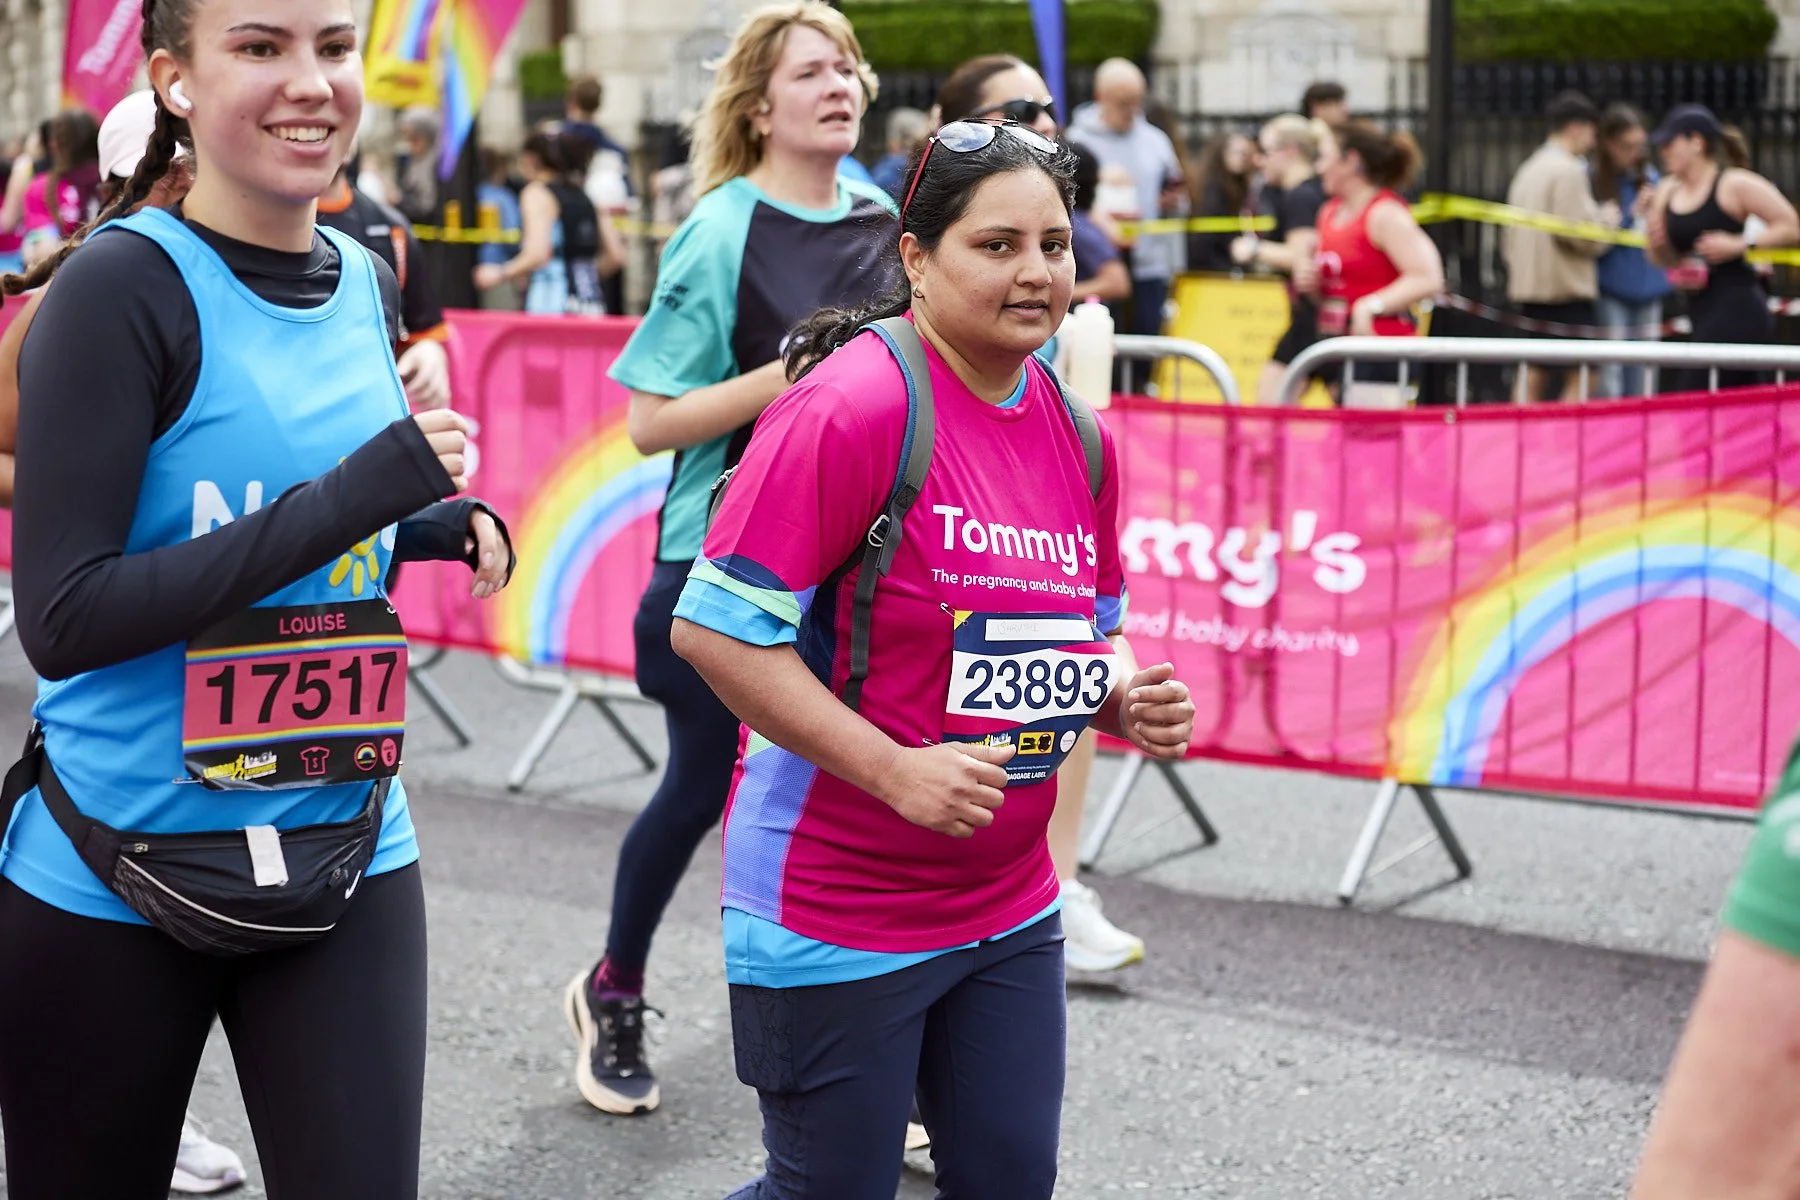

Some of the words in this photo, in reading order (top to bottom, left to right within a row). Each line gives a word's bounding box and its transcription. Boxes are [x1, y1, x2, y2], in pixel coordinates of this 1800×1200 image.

[933, 504, 1096, 577] Tommy's
[1120, 510, 1366, 608] my's
[931, 569, 958, 584] The
[963, 574, 1027, 592] pregnancy
[1029, 580, 1048, 592] and
[1050, 581, 1076, 599] baby
[1077, 584, 1097, 601] chari
[279, 612, 347, 635] LOUISE
[1173, 608, 1250, 653] baby
[1252, 623, 1361, 657] charity
[206, 651, 398, 725] 17517
[960, 659, 1109, 710] 23893
[1031, 771, 1046, 779] LABEL
